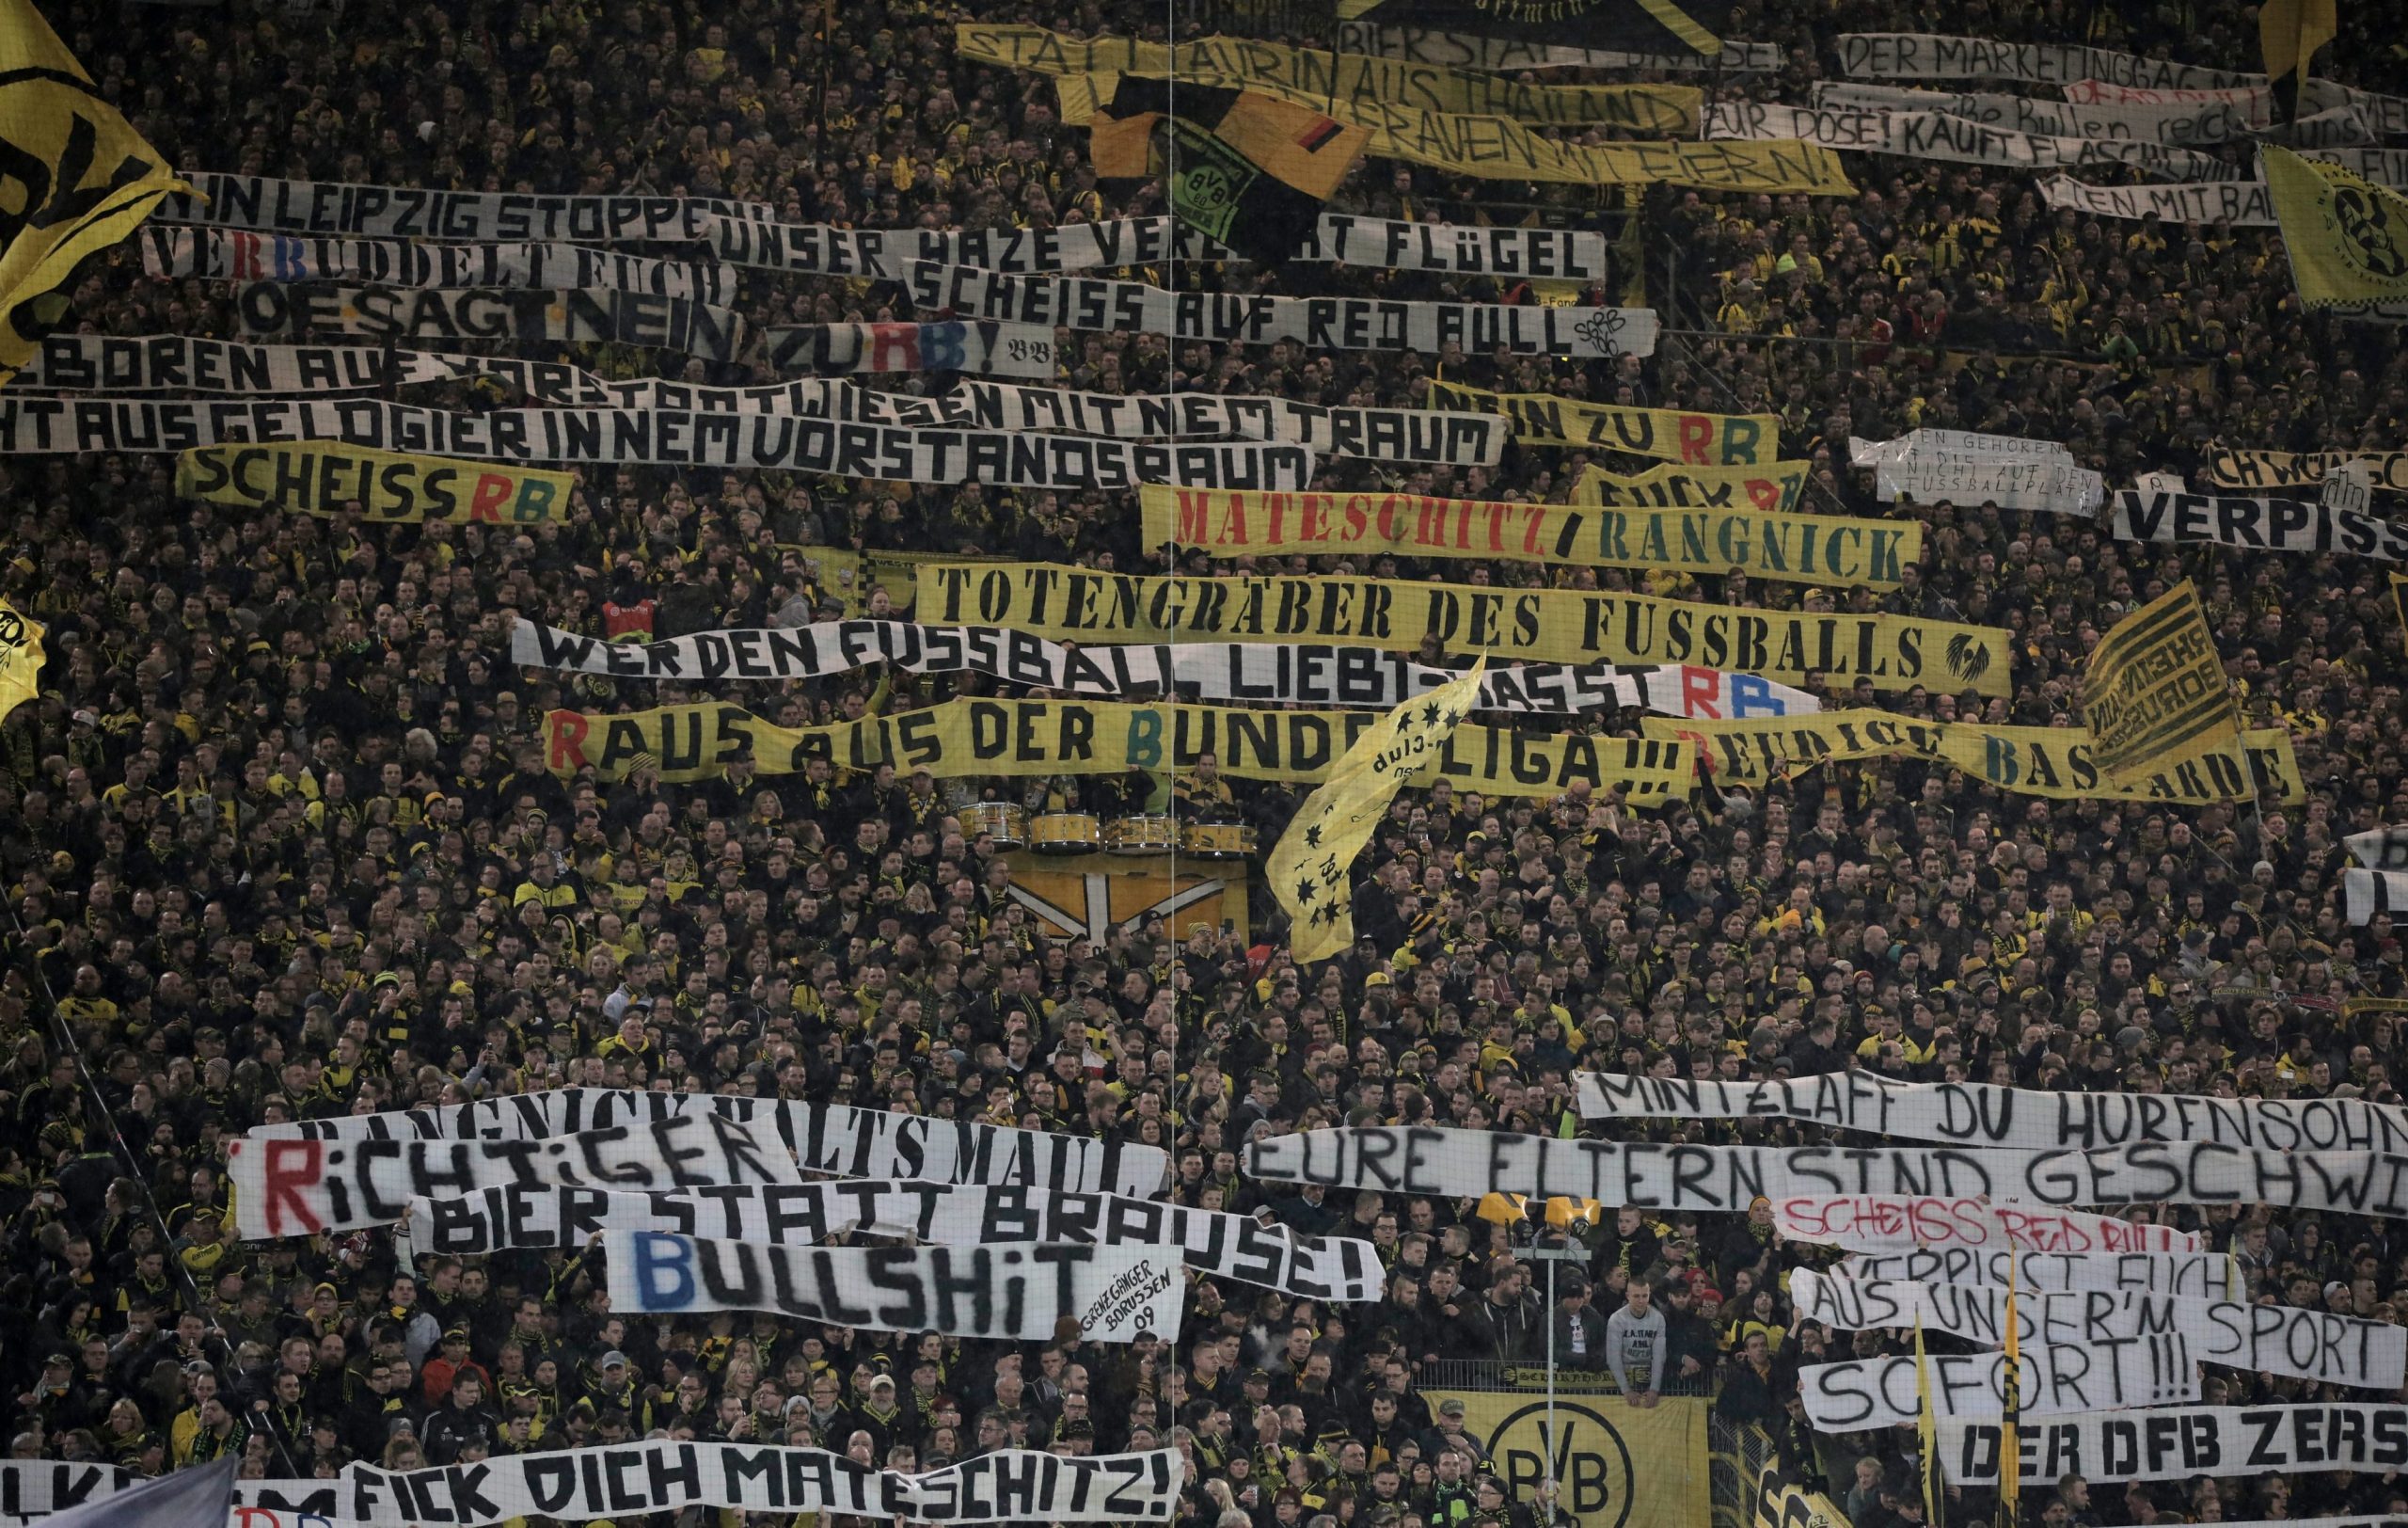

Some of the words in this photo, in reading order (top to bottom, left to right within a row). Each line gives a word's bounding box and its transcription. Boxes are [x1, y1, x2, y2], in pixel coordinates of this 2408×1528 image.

[1352, 57, 1442, 113] AUS
[1846, 35, 1919, 73] DER
[1792, 108, 1891, 148] DOSE!
[203, 174, 262, 225] IN
[274, 181, 482, 236] LEIPZIG
[2150, 188, 2208, 220] MIT
[149, 226, 552, 289] VERBUDDELT
[577, 248, 721, 306] EUCH
[720, 216, 887, 279] UNSER
[1386, 221, 1589, 279] FLÜGEL
[354, 285, 556, 340] SAGT
[567, 289, 737, 363] NEIN
[914, 260, 1145, 330] SCHEISS
[1177, 292, 1275, 338] AUF
[1308, 298, 1408, 352] RED
[771, 322, 864, 374] ZU
[873, 319, 1001, 374] RB!
[8, 337, 272, 390] BOREN
[1018, 387, 1126, 435] MIT
[1286, 401, 1490, 463] TRAUM
[75, 401, 198, 451] AUS
[210, 399, 531, 459] GELDGIER
[1578, 408, 1655, 452] ZU
[1678, 414, 1762, 466] RB
[1963, 433, 2063, 455] GEHÖREN
[194, 447, 458, 517] SCHEISS
[470, 473, 557, 521] RB
[1905, 475, 2089, 499] FUSSBALLPLAT
[1176, 491, 1547, 555] MATESCHITZ
[1599, 510, 1905, 582] RANGNICK
[938, 567, 1392, 640] TOTENGRÄBER
[1427, 589, 1541, 647] DES
[1581, 597, 1923, 679] FUSSBALLS
[533, 621, 684, 676] WER
[693, 628, 821, 678] DEN
[840, 620, 1202, 697] FUSSBALL
[1418, 663, 1660, 713] ASST
[550, 707, 753, 770] RAUS
[792, 710, 942, 772] AUS
[971, 701, 1094, 761] DER
[1126, 708, 1602, 788] BUNDELIGA
[1982, 733, 2289, 799] BASARDE
[1936, 1083, 2013, 1140] DU
[1250, 1128, 1446, 1196] EURE
[1489, 1132, 1769, 1209] ELTERN
[1786, 1145, 1992, 1200] SIND
[429, 1183, 610, 1253] BIER
[650, 1180, 953, 1248] STATT
[1785, 1197, 1988, 1247] SCHEISS
[1994, 1207, 2093, 1253] RED
[1080, 1259, 1153, 1332] GRENZGÄNGER
[1105, 1266, 1171, 1332] BORUSSEN
[1133, 1305, 1155, 1330] 09
[1812, 1274, 1899, 1329] AUS
[2207, 1301, 2390, 1380] SPORT
[1961, 1422, 2081, 1478] DER
[2101, 1414, 2222, 1476] DFB
[353, 1463, 500, 1522] FICK
[522, 1443, 702, 1512] DICH
[720, 1447, 1172, 1520] MATESCHITZ!
